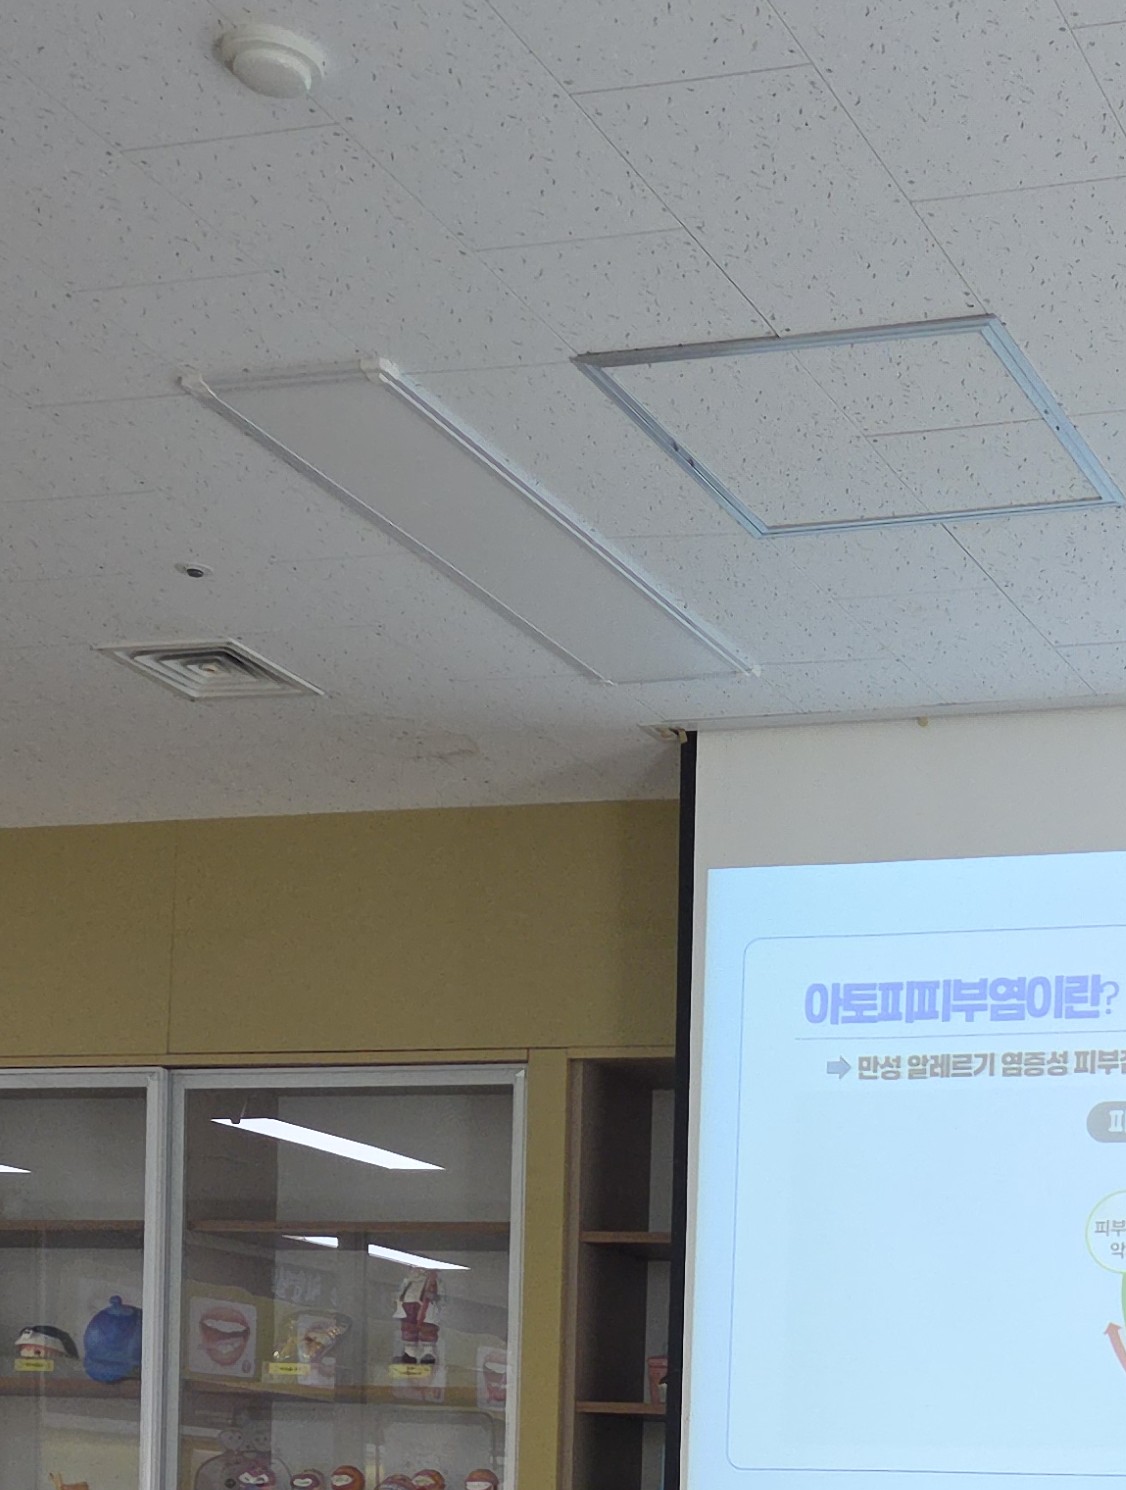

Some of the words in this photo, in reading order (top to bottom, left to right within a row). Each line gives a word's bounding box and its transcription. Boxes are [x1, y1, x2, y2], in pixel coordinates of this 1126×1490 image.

[804, 974, 1119, 1024] 아토피피부염이란?
[858, 1054, 901, 1080] 만성
[907, 1052, 995, 1079] 알레르기
[1001, 1051, 1068, 1078] 염증성
